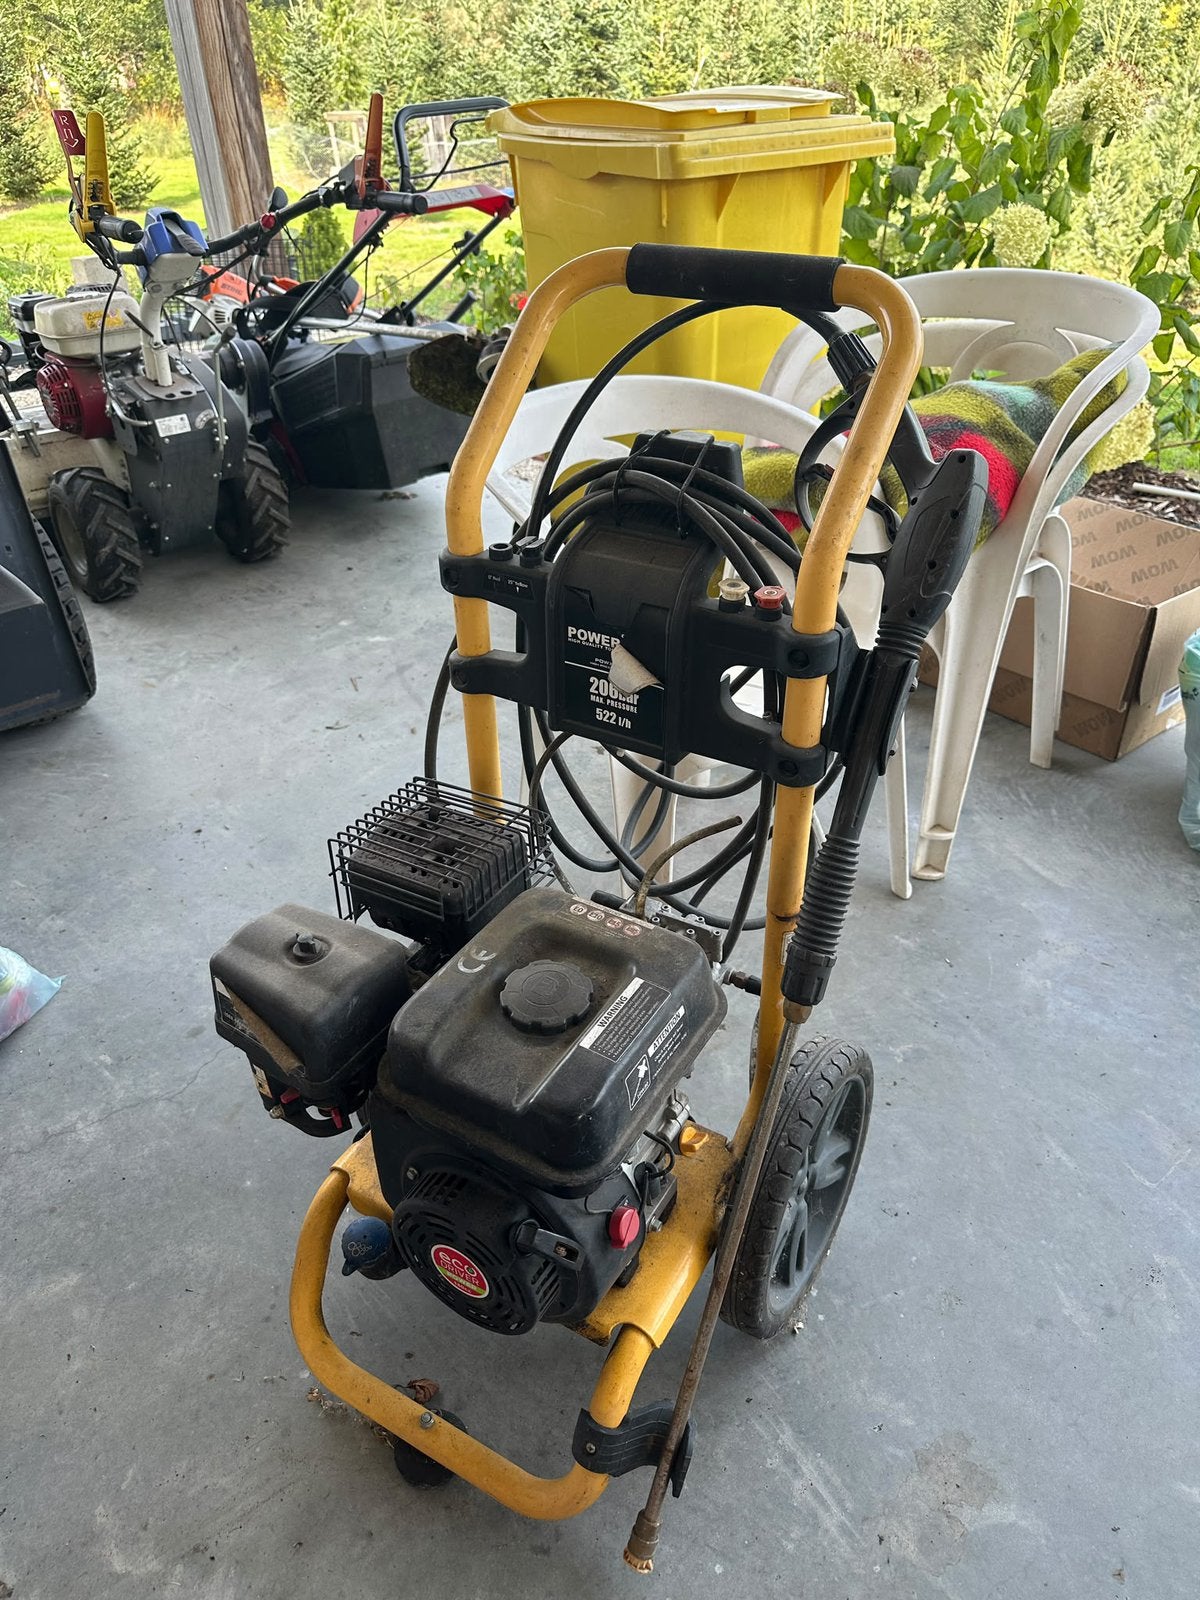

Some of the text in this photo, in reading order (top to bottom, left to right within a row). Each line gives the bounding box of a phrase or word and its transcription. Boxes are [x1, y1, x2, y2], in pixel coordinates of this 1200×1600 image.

[567, 625, 621, 648] POWER
[581, 640, 603, 650] QUALITY
[590, 694, 638, 714] MAX. PRESSURE
[595, 707, 617, 725] 522
[597, 995, 629, 1029] WARNING
[652, 1011, 682, 1051] ATTENTION
[438, 1251, 478, 1278] eco
[440, 1259, 480, 1287] DRIVER
